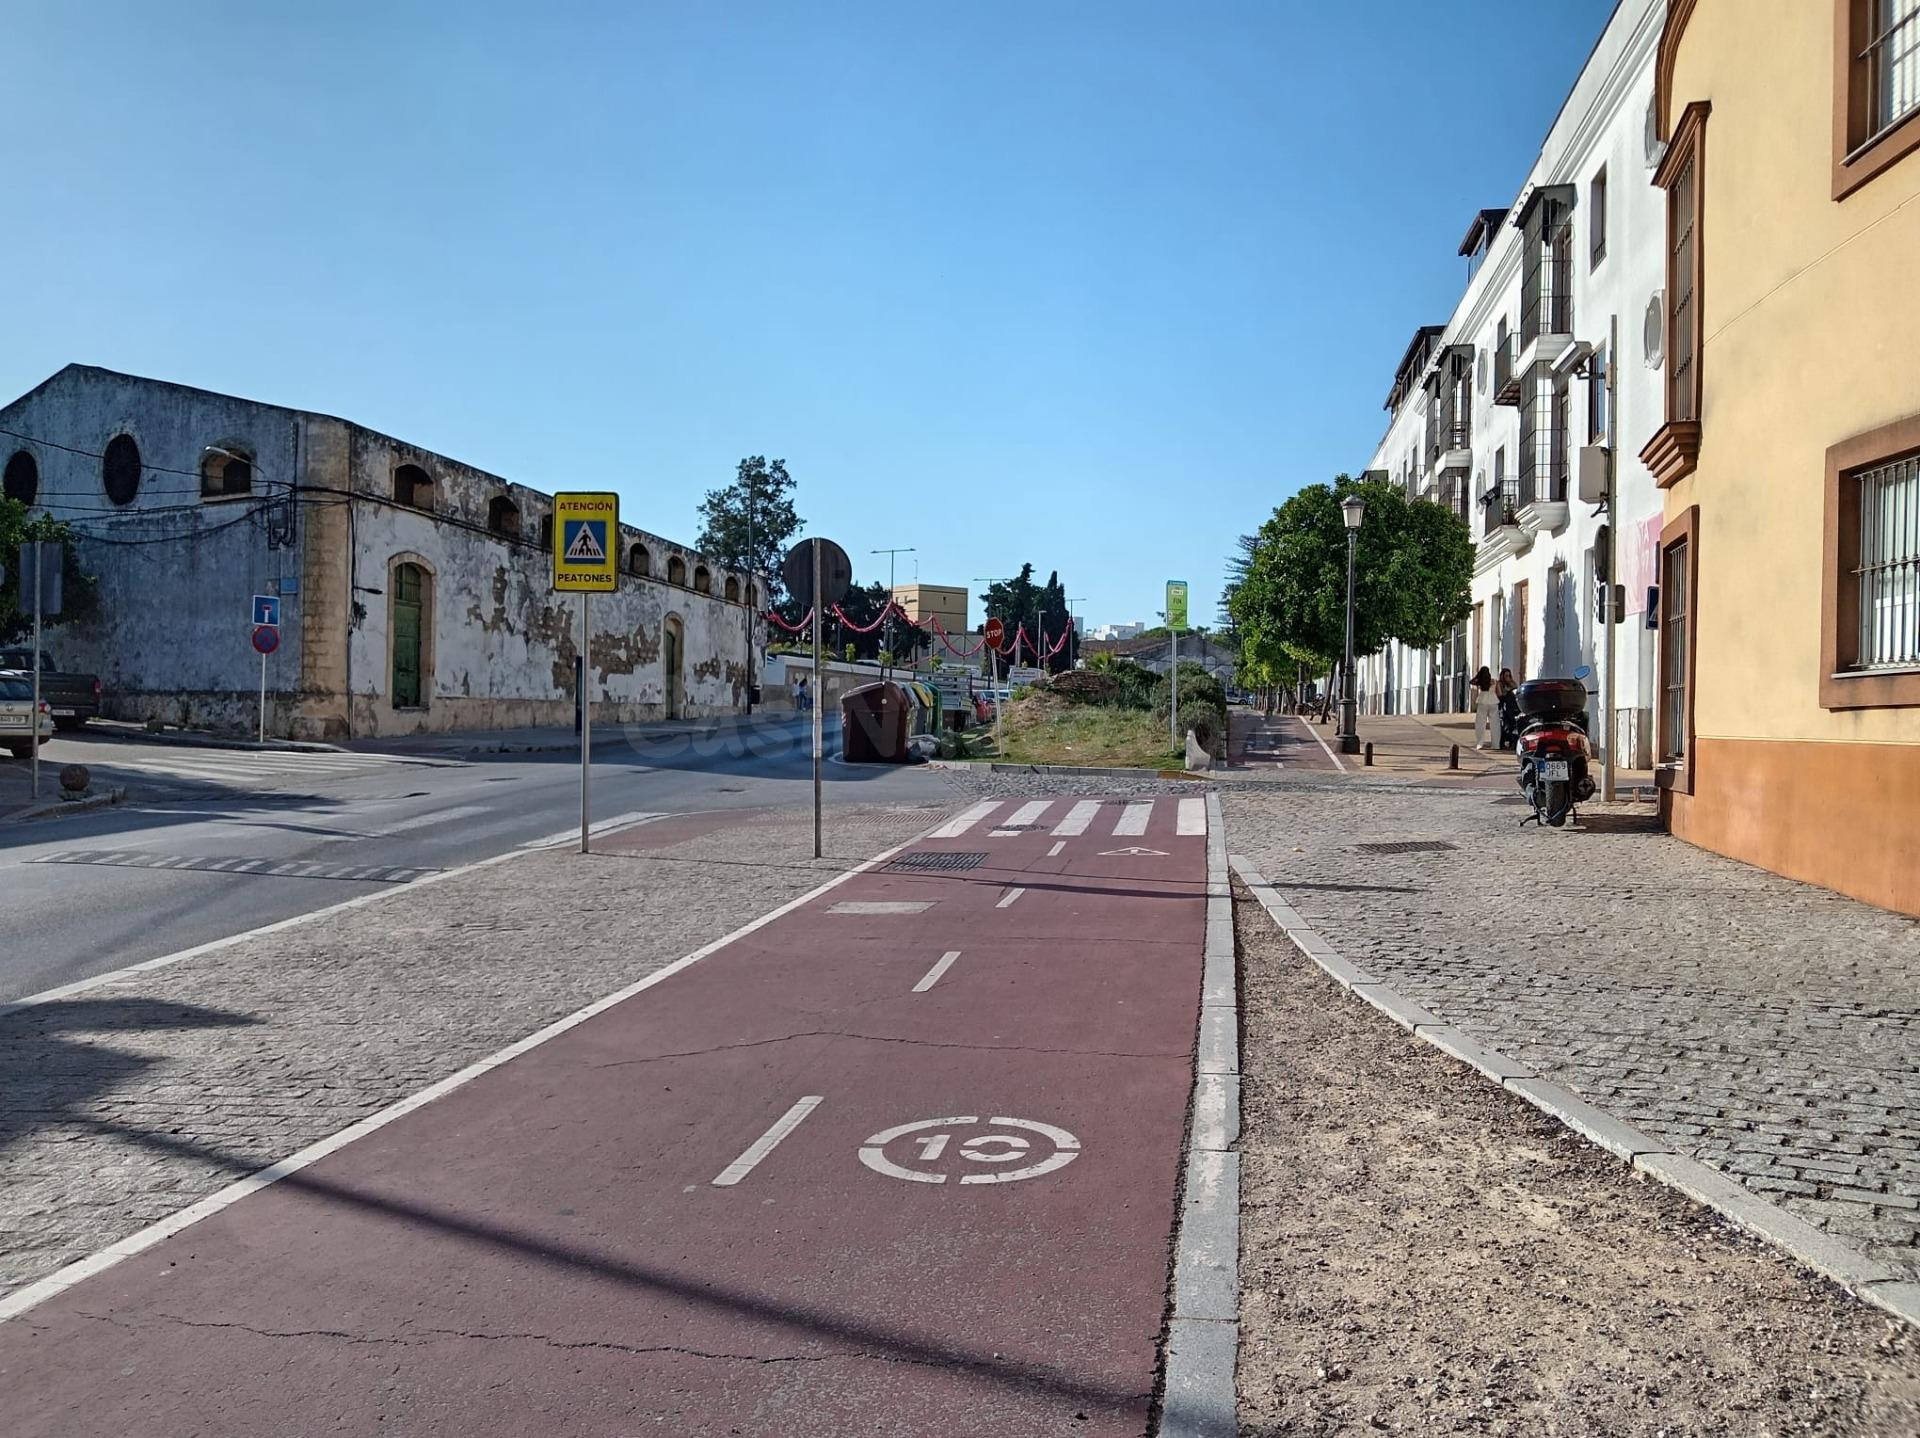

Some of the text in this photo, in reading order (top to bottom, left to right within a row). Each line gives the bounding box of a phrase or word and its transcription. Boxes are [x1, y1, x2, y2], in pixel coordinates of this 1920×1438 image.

[559, 501, 613, 511] ATENCIÓN
[557, 573, 612, 583] PEATONES
[986, 628, 1002, 639] STOP
[915, 1134, 1031, 1163] 10
